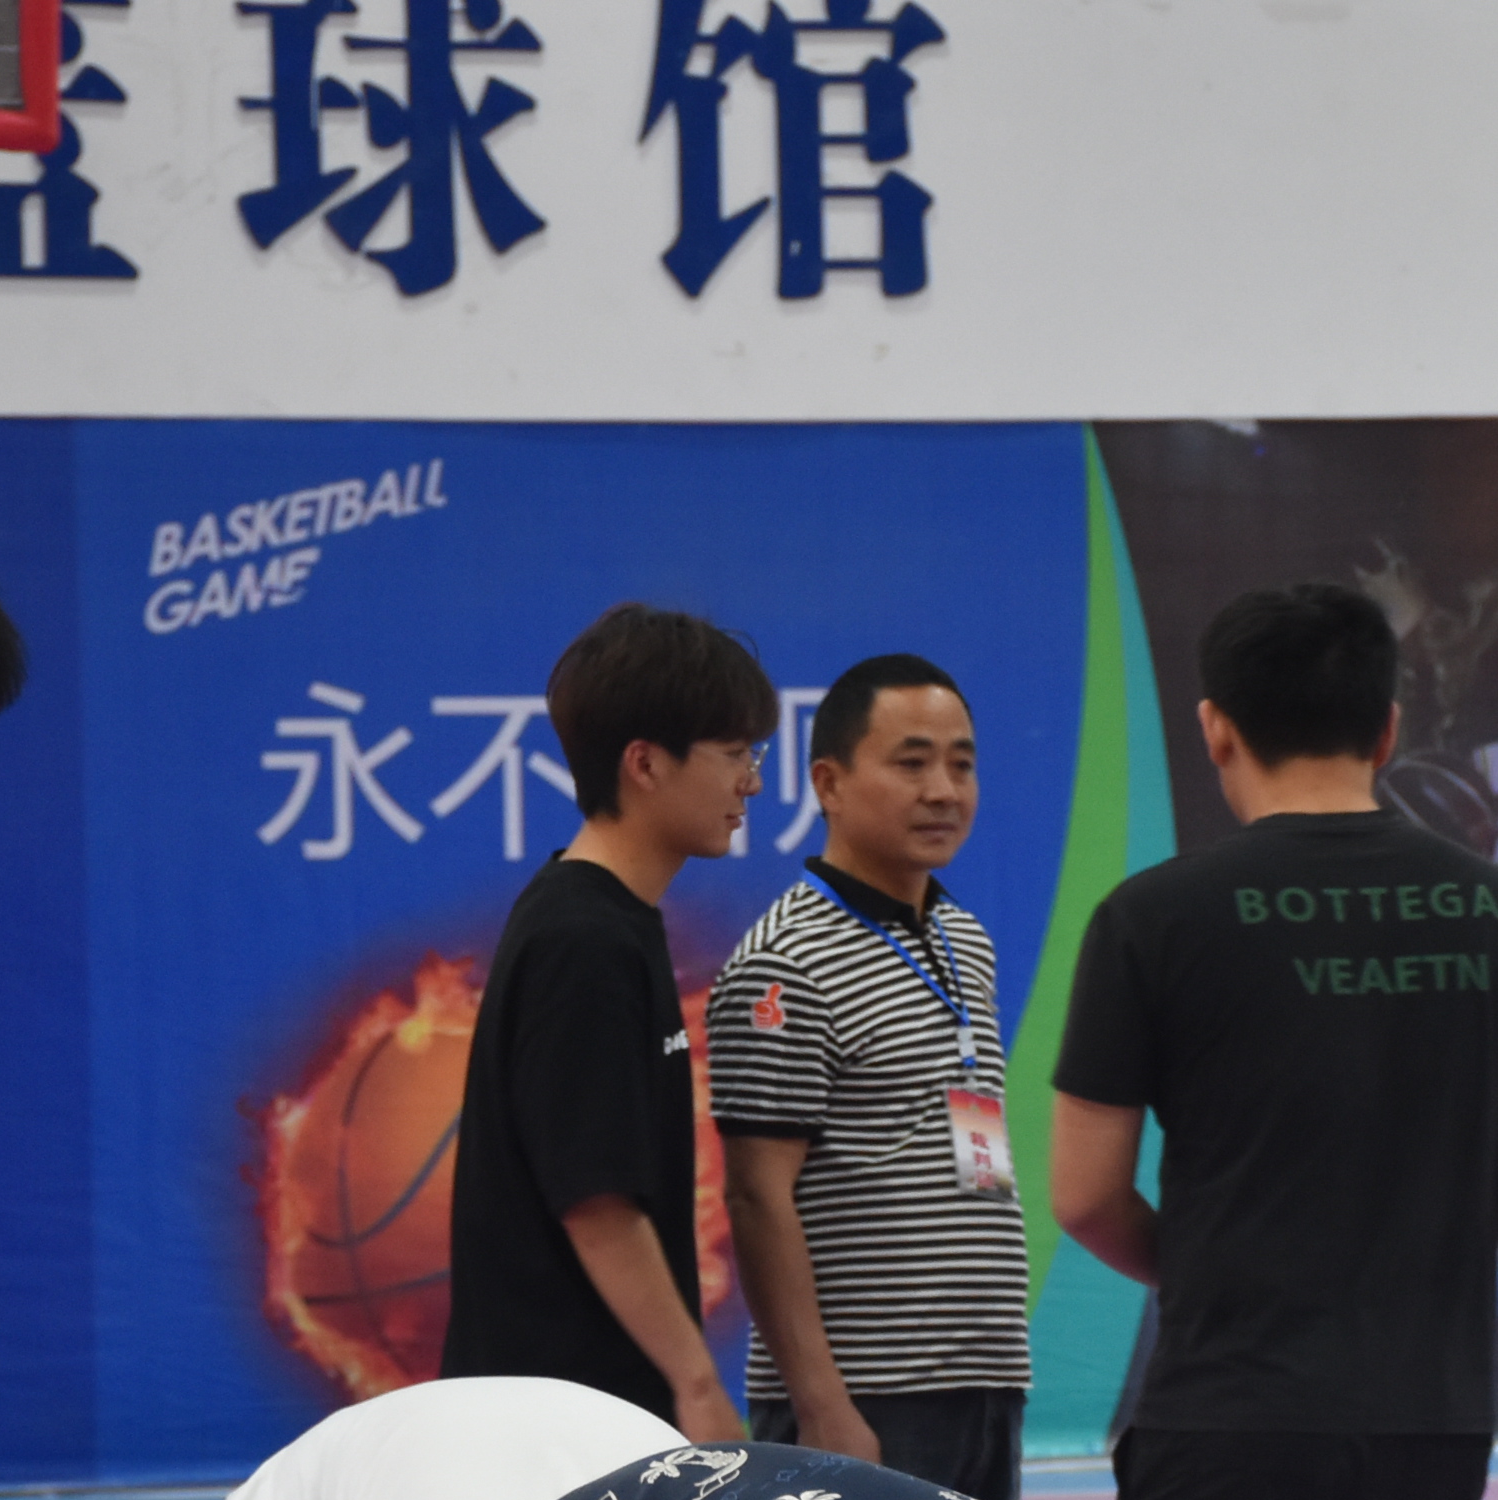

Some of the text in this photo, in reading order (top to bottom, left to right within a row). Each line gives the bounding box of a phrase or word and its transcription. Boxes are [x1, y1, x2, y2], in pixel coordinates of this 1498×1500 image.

[149, 457, 448, 578] BASKETBALL
[143, 546, 321, 635] GAME
[1291, 954, 1491, 996] VEAETN
